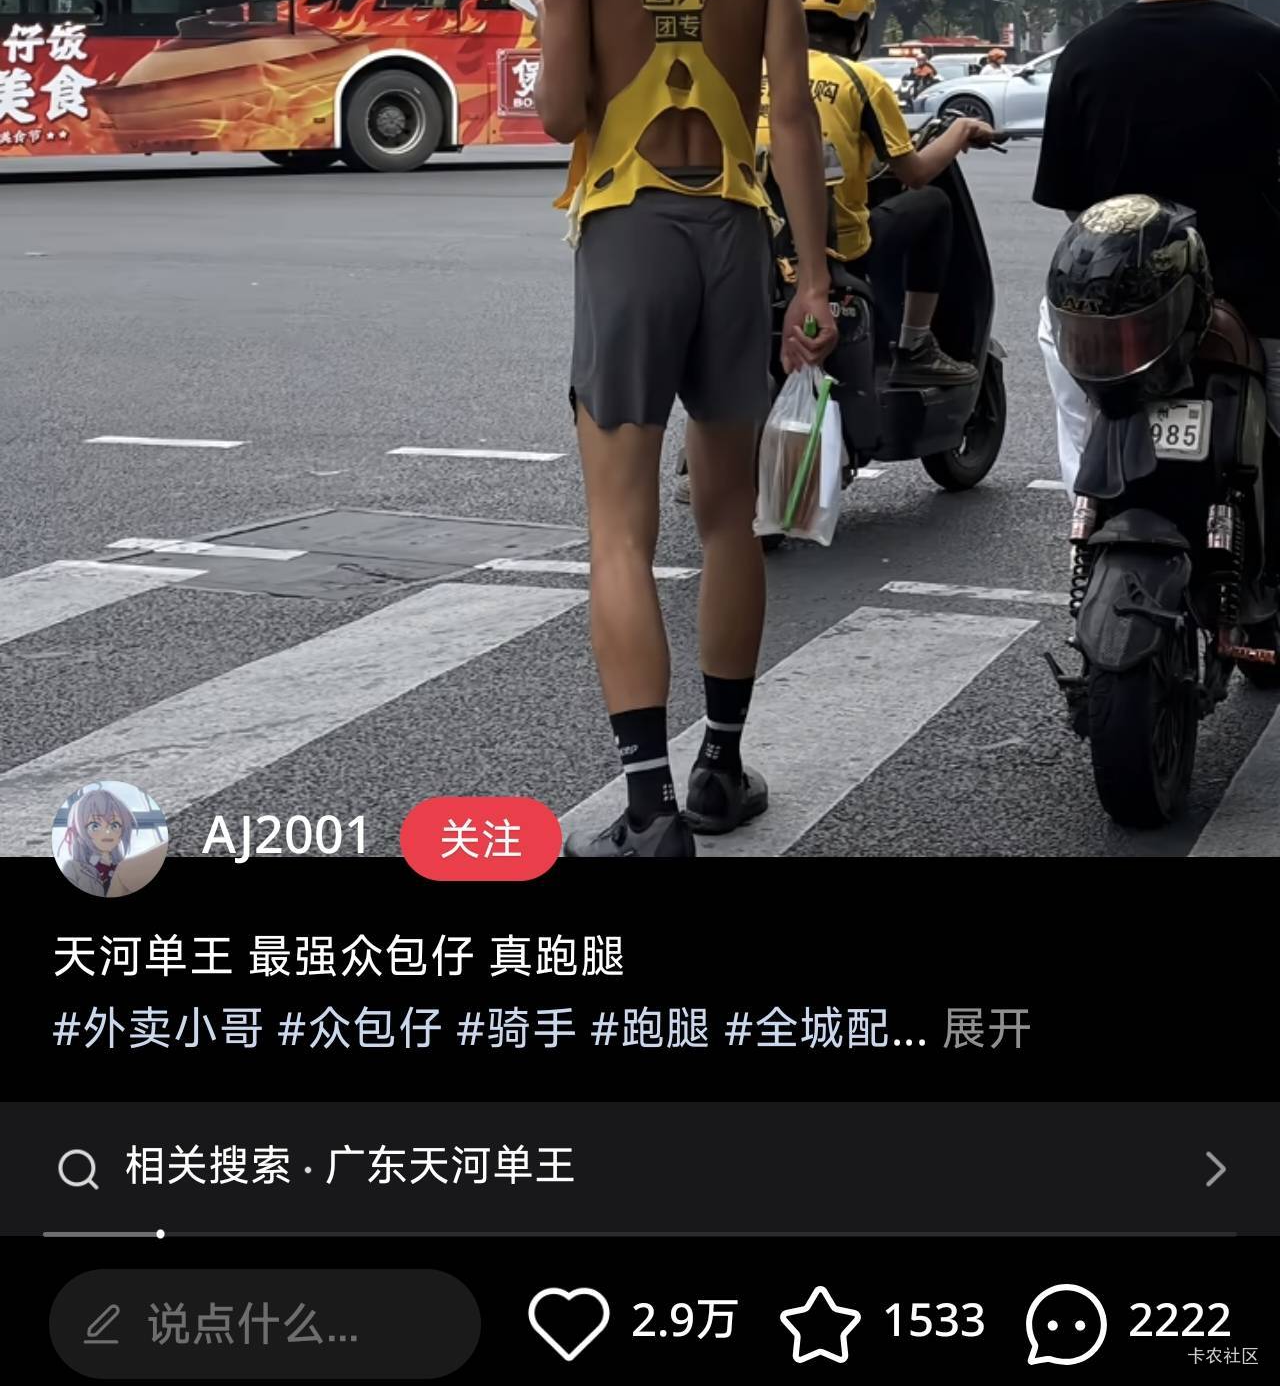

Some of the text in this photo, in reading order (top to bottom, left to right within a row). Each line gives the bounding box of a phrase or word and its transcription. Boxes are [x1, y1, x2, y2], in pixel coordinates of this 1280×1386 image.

[656, 15, 701, 38] 团专
[3, 21, 88, 63] 仔饭
[1151, 422, 1198, 447] 985
